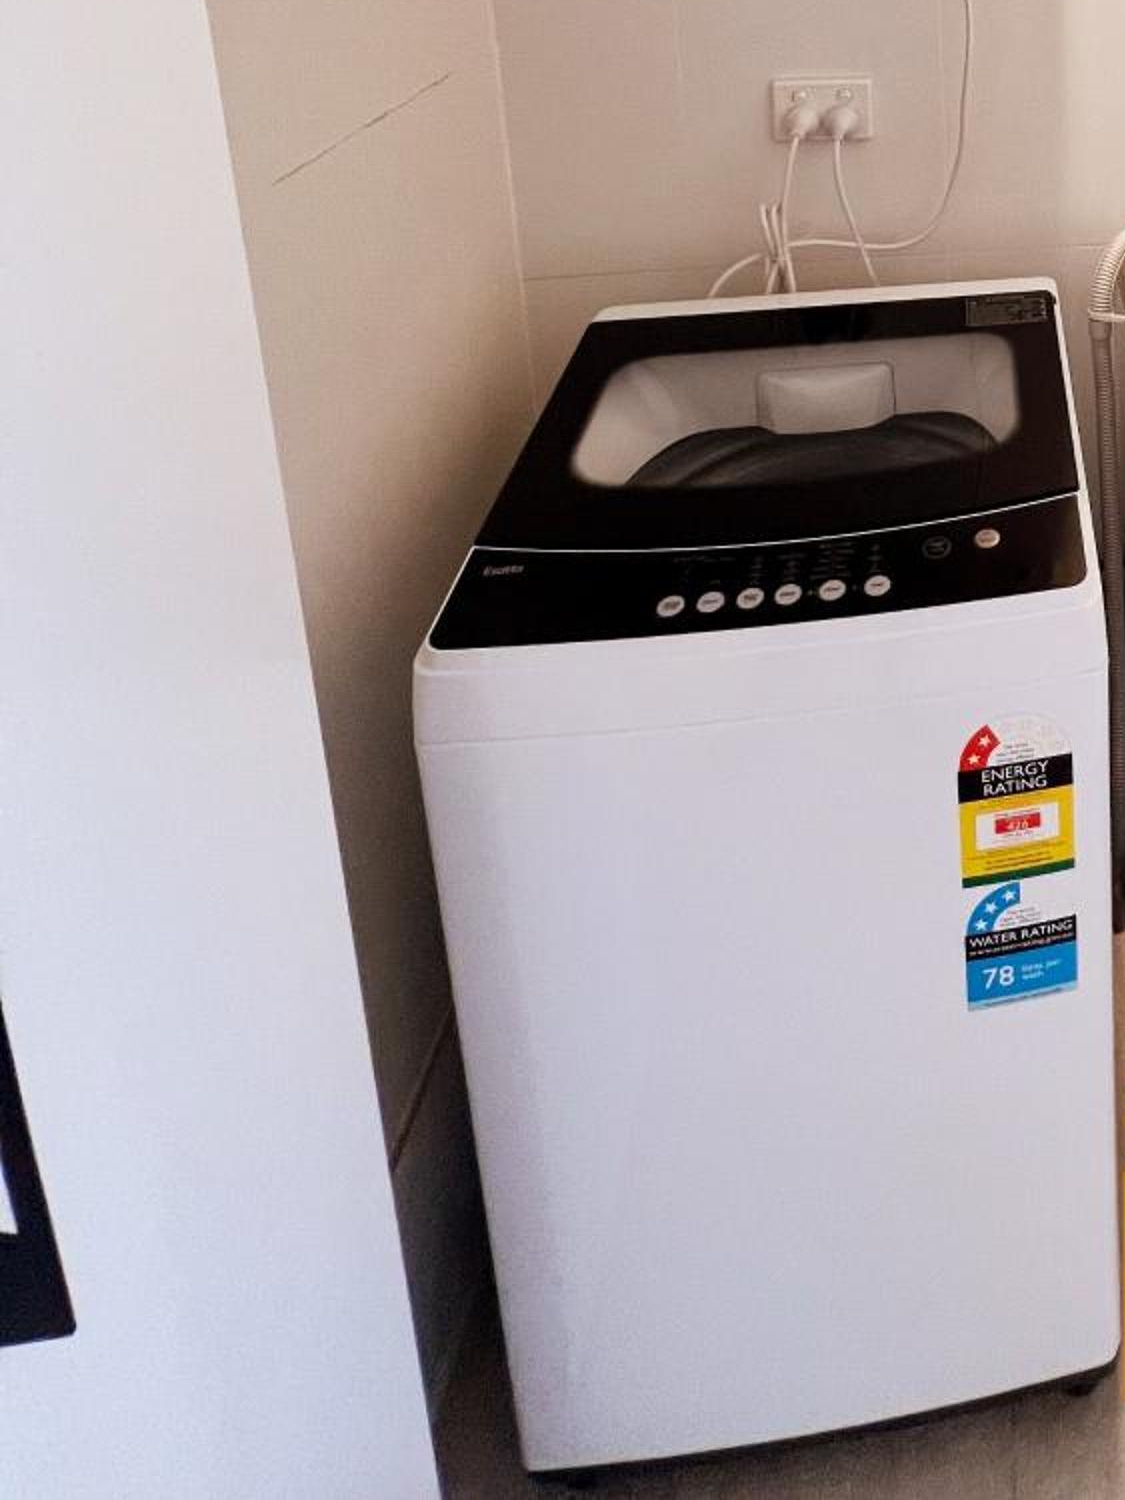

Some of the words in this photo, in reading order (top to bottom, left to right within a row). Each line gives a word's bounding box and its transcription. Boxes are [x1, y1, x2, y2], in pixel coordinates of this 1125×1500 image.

[981, 760, 1049, 783] ENERGY
[983, 773, 1048, 797] RATING
[969, 932, 1017, 947] WATER
[1021, 920, 1073, 939] RATING
[982, 965, 1014, 989] 78
